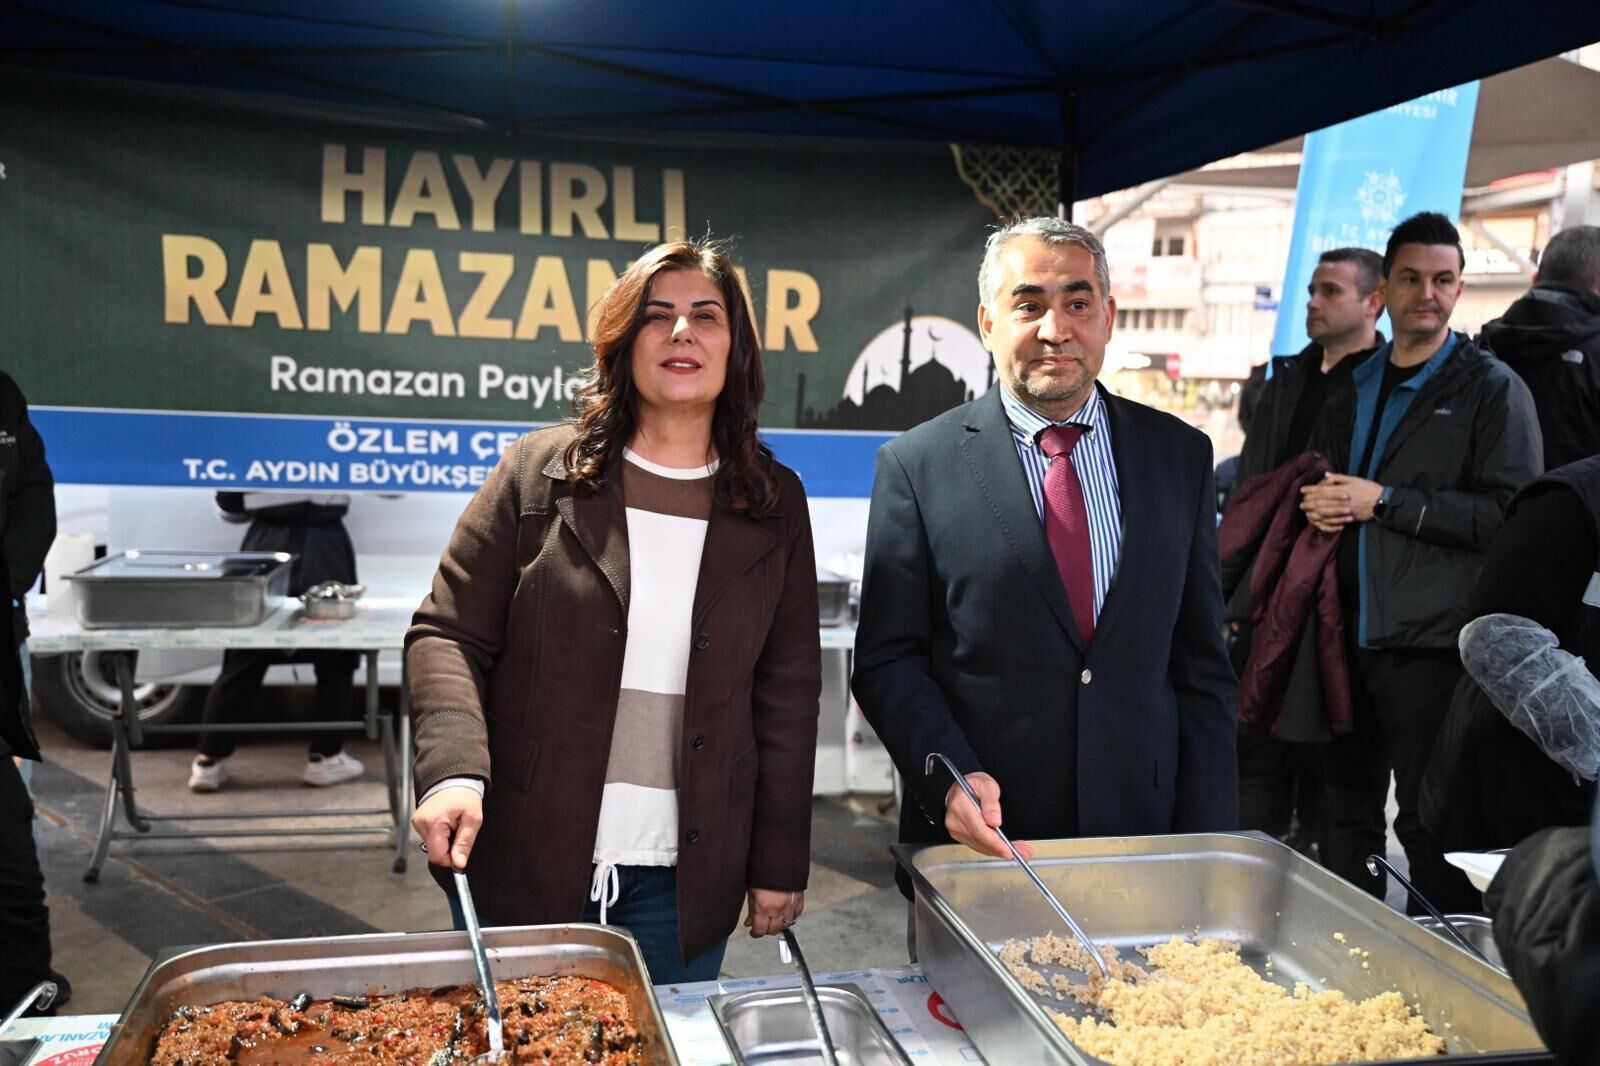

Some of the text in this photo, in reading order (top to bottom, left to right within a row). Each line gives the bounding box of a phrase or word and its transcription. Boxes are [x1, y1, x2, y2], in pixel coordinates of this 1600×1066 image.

[321, 144, 686, 245] HAYIRLI
[271, 356, 465, 398] Ramazan
[328, 422, 459, 455] ÖZLEM
[183, 458, 496, 489] T.C. AYDIN BÜYÜKŞE
